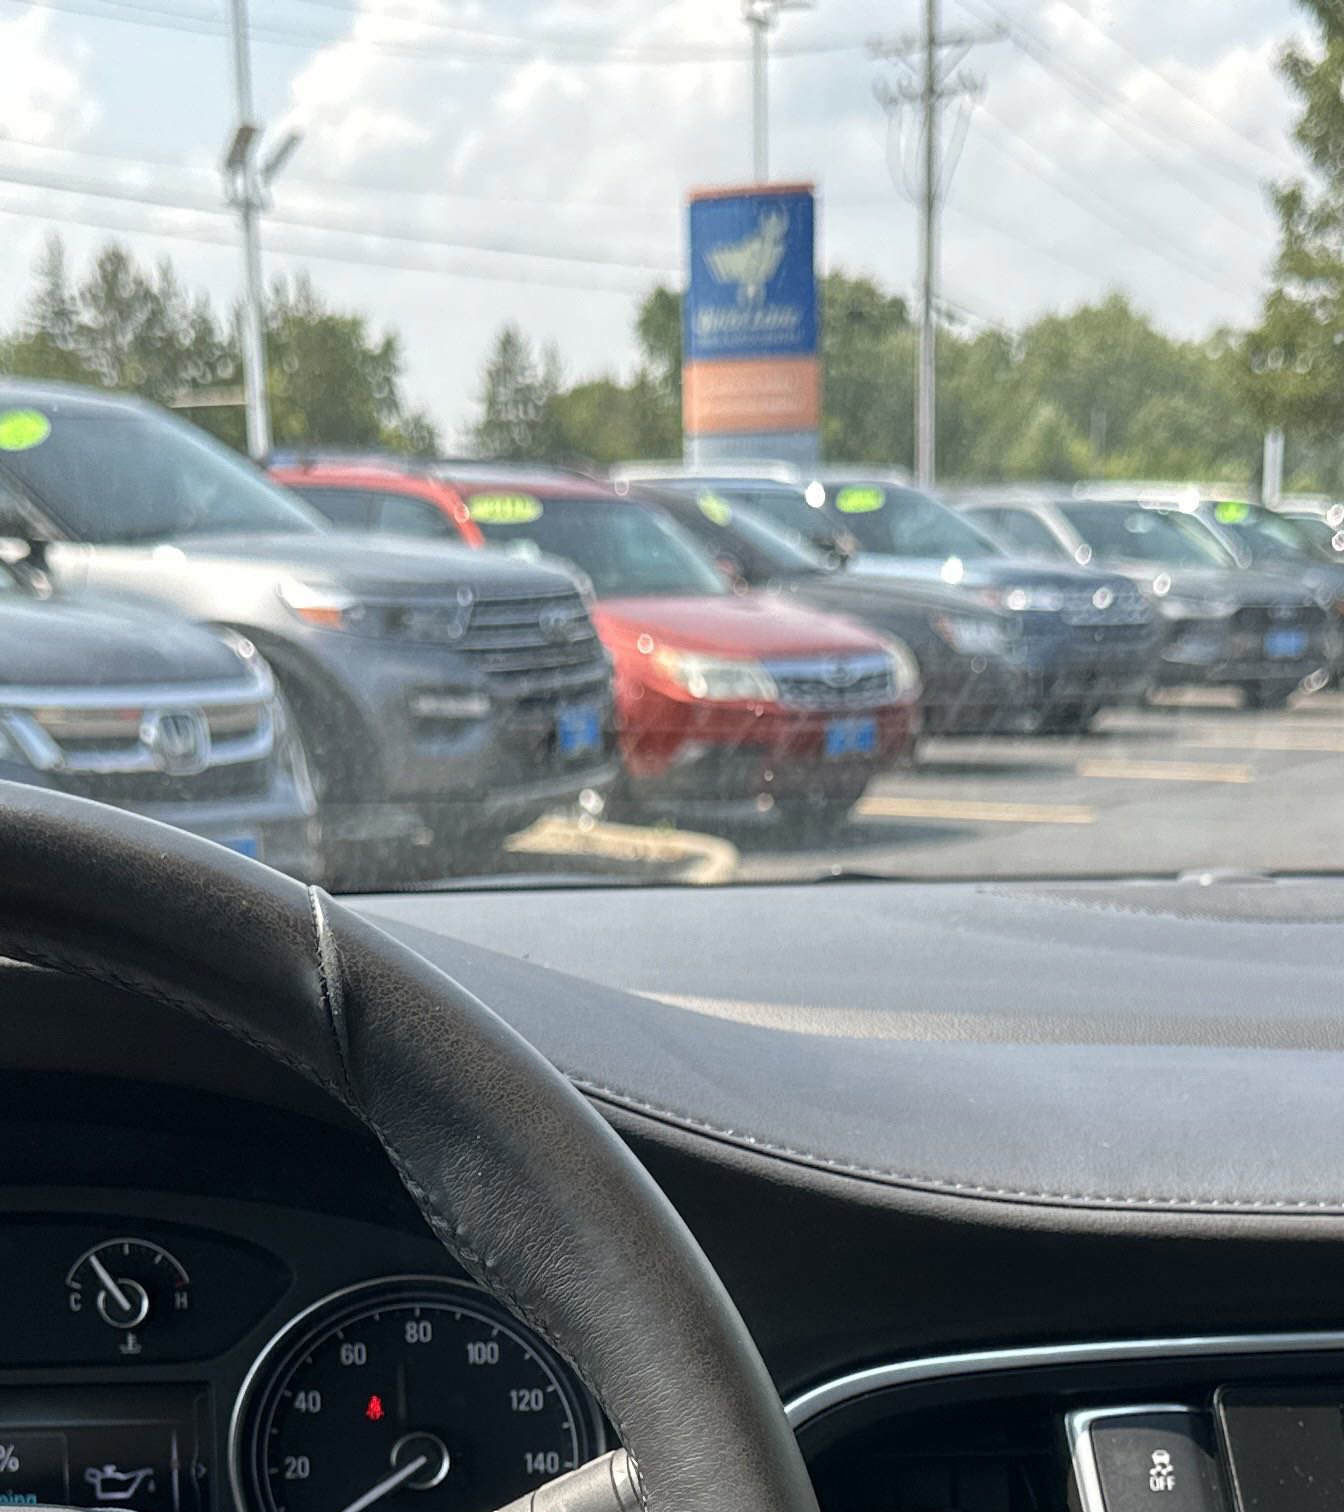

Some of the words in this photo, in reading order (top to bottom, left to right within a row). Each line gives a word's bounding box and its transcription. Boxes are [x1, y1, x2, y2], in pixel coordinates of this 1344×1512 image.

[70, 1294, 82, 1311] C
[175, 1294, 188, 1310] H
[406, 1321, 432, 1344] 80
[340, 1343, 367, 1366] 60
[466, 1342, 499, 1365] 100
[294, 1391, 322, 1413] 40
[510, 1389, 545, 1412] 120
[285, 1456, 310, 1478] 20
[525, 1453, 559, 1475] 140
[1149, 1477, 1175, 1492] OFF
